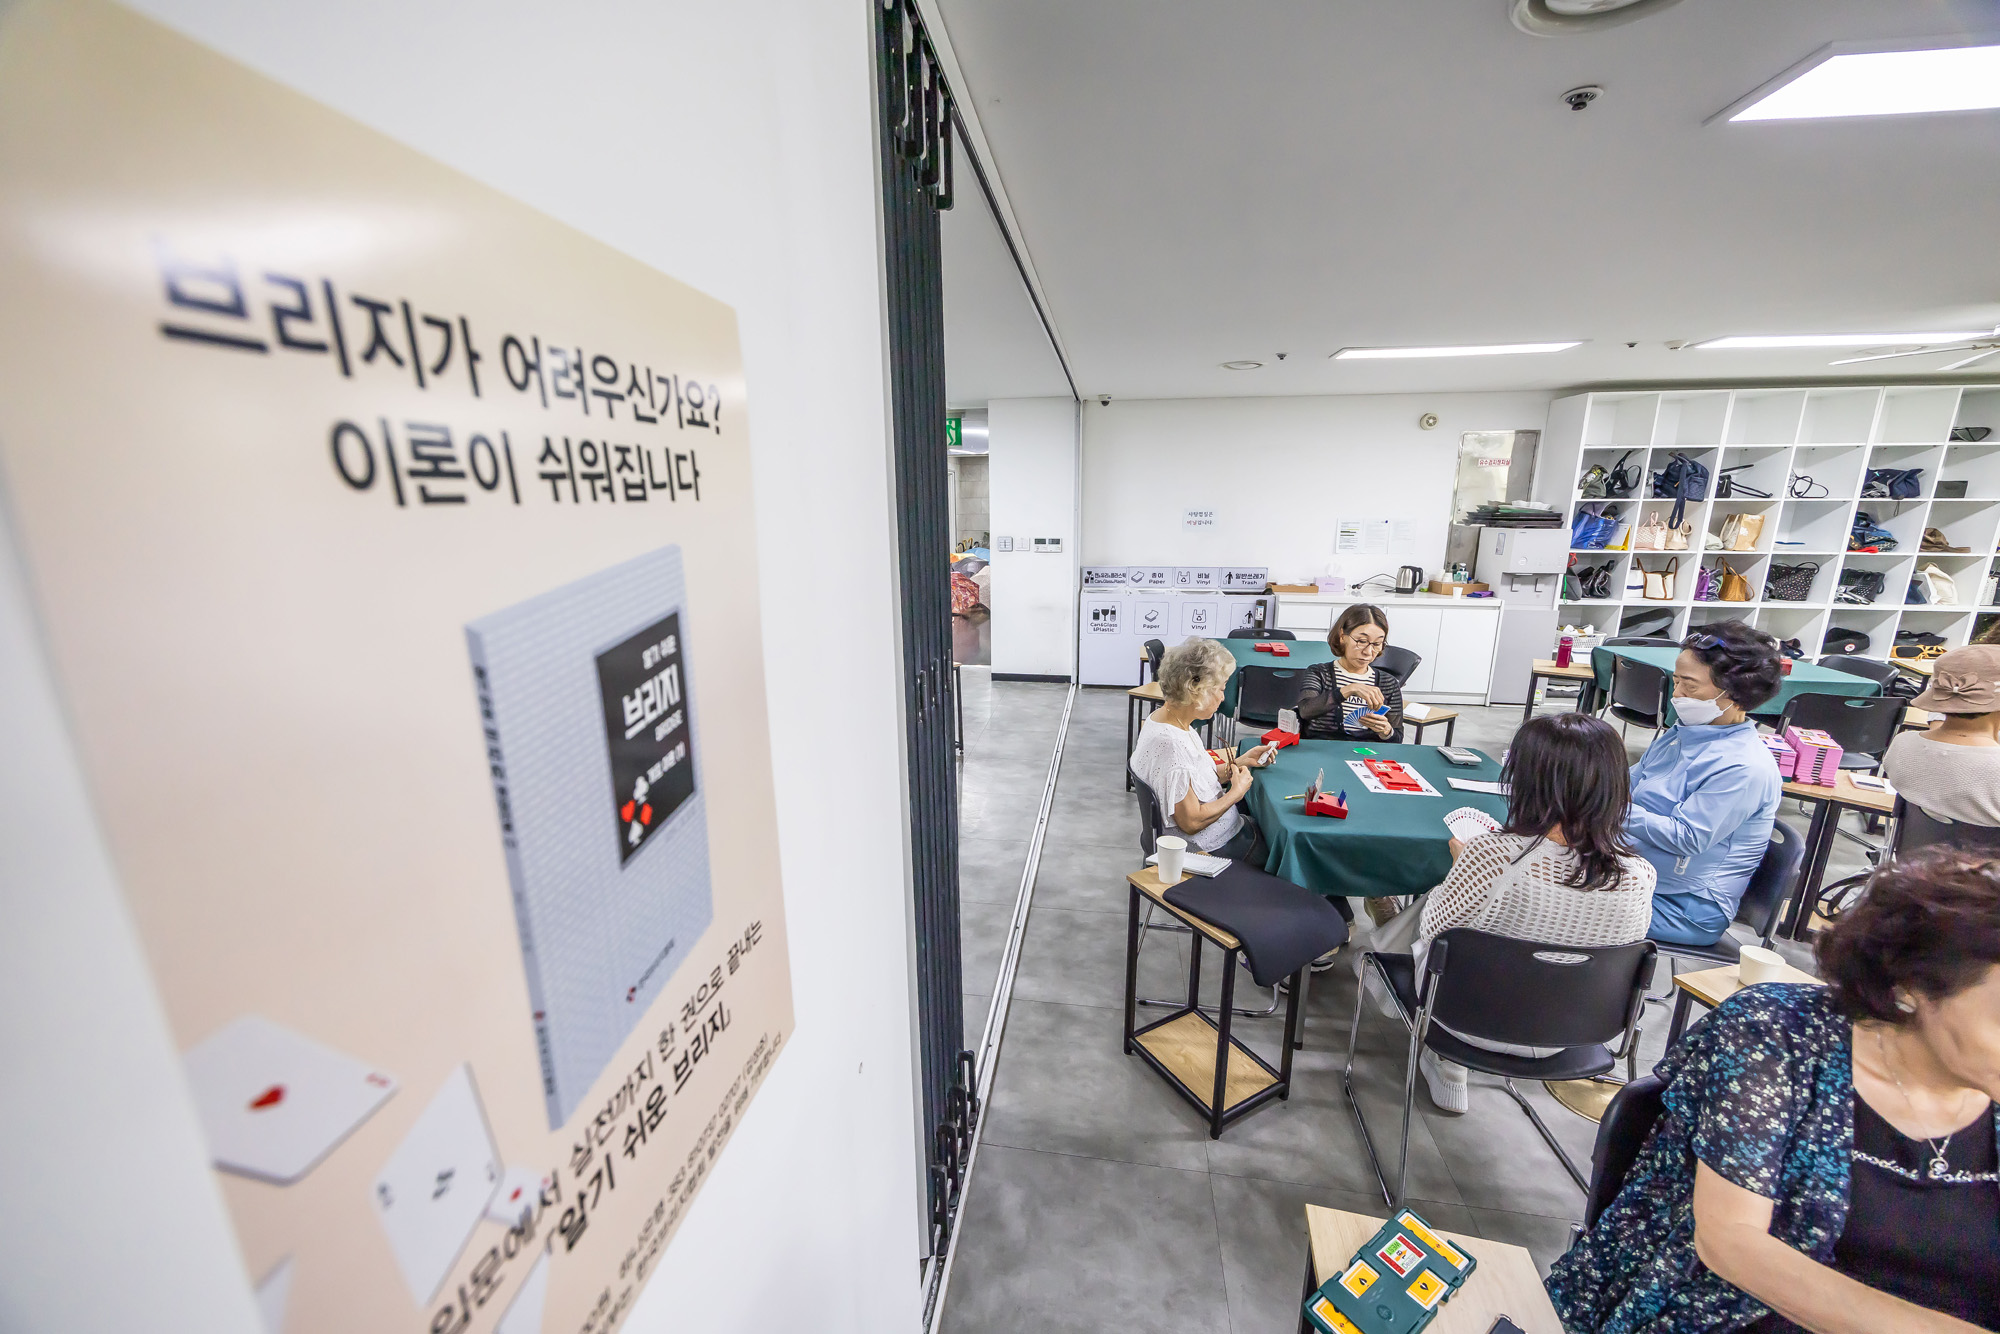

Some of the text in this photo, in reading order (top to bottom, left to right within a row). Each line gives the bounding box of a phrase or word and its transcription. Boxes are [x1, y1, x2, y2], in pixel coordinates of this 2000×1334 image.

[154, 246, 722, 434] 브리지가 어려우신가요?
[330, 417, 701, 506] 이론이 쉬워집니다
[622, 663, 681, 740] 브리지
[569, 1049, 654, 1178] 실전까지
[657, 1022, 676, 1063] 한
[680, 964, 725, 1033] 권으로
[726, 919, 763, 976] 끝내는
[623, 1084, 668, 1160] 쉬운
